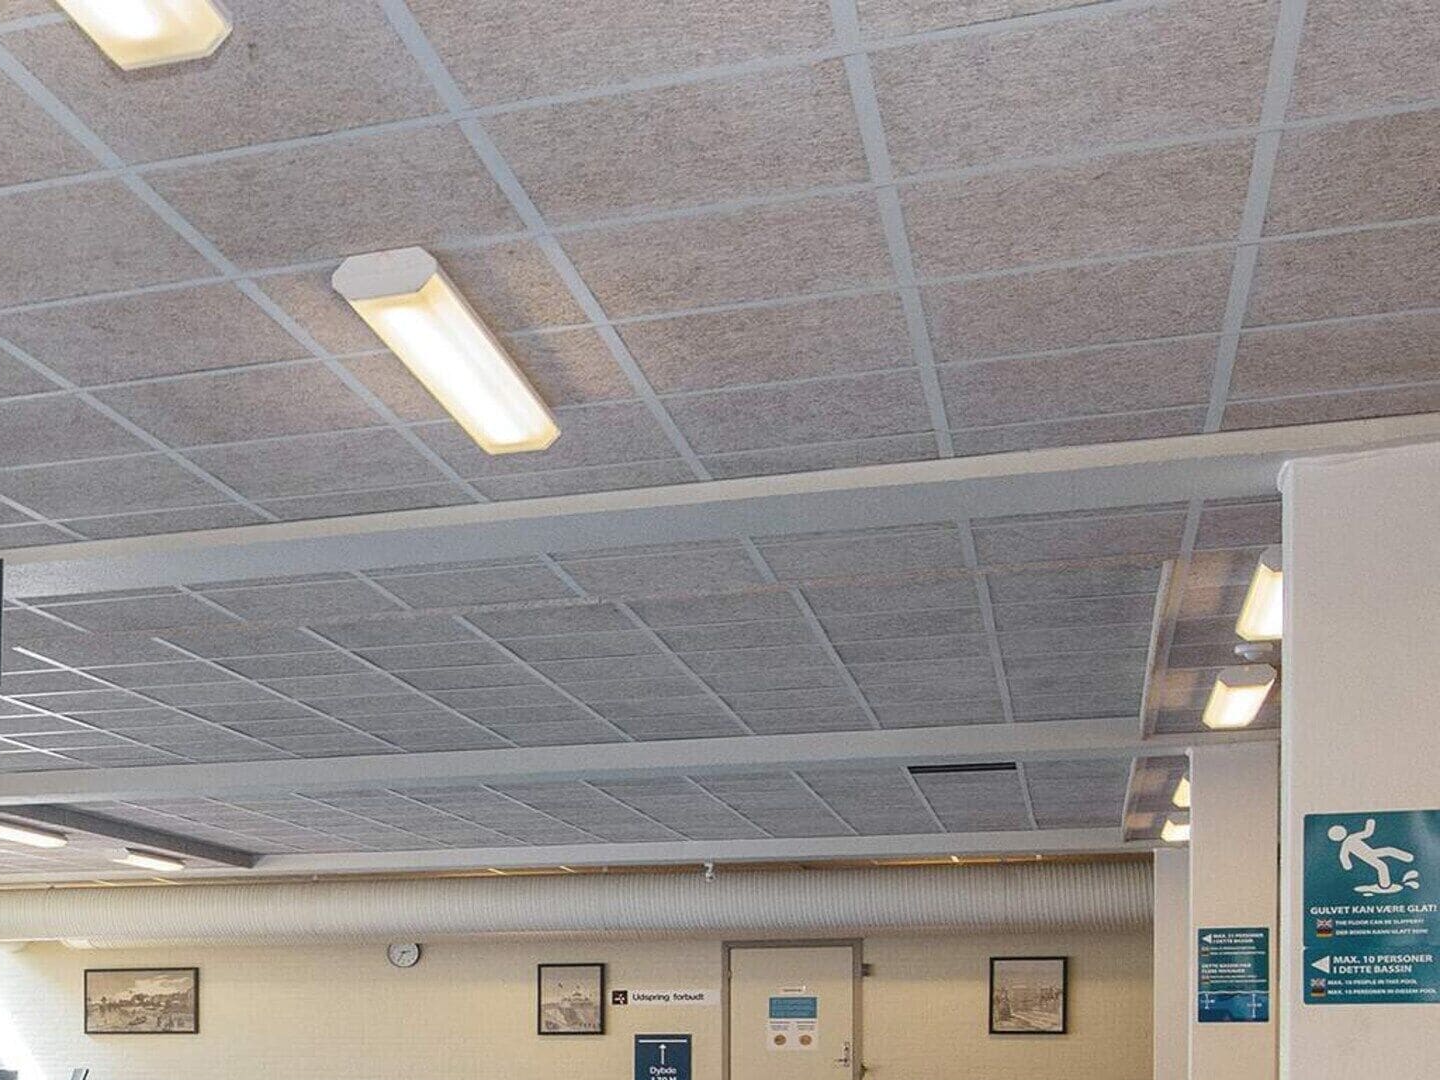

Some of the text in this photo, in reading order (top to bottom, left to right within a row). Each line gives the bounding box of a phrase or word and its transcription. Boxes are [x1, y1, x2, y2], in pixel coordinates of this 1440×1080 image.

[1310, 903, 1437, 915] GULVET KAN VÆRE GLAT!
[1333, 954, 1433, 964] MAX. 10 PERSONER
[1339, 965, 1371, 974] DETTE
[1374, 964, 1412, 973] BASSIN
[632, 992, 705, 1002] Udspring forbudt
[650, 1066, 677, 1076] Dybde
